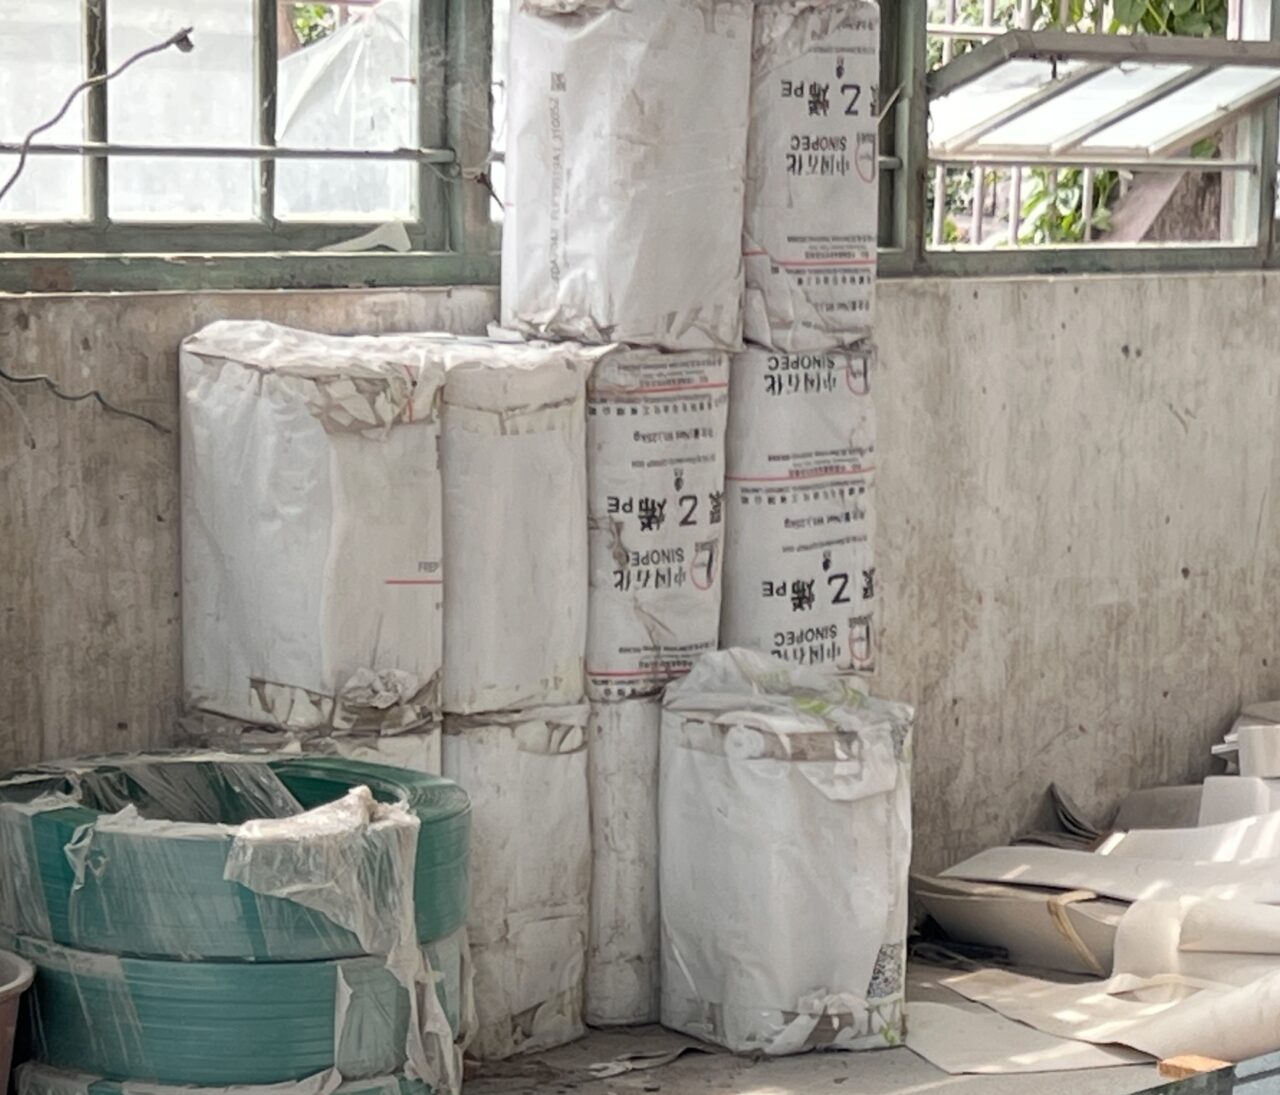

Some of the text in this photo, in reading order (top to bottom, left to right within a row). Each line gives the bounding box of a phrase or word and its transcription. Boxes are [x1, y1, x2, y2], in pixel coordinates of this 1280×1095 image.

[781, 80, 804, 98] PE
[791, 135, 848, 151] SINOPEC
[768, 354, 835, 371] SINOPEC
[607, 496, 633, 514] PE
[762, 581, 786, 598] PE
[774, 624, 838, 647] SINOPEC
